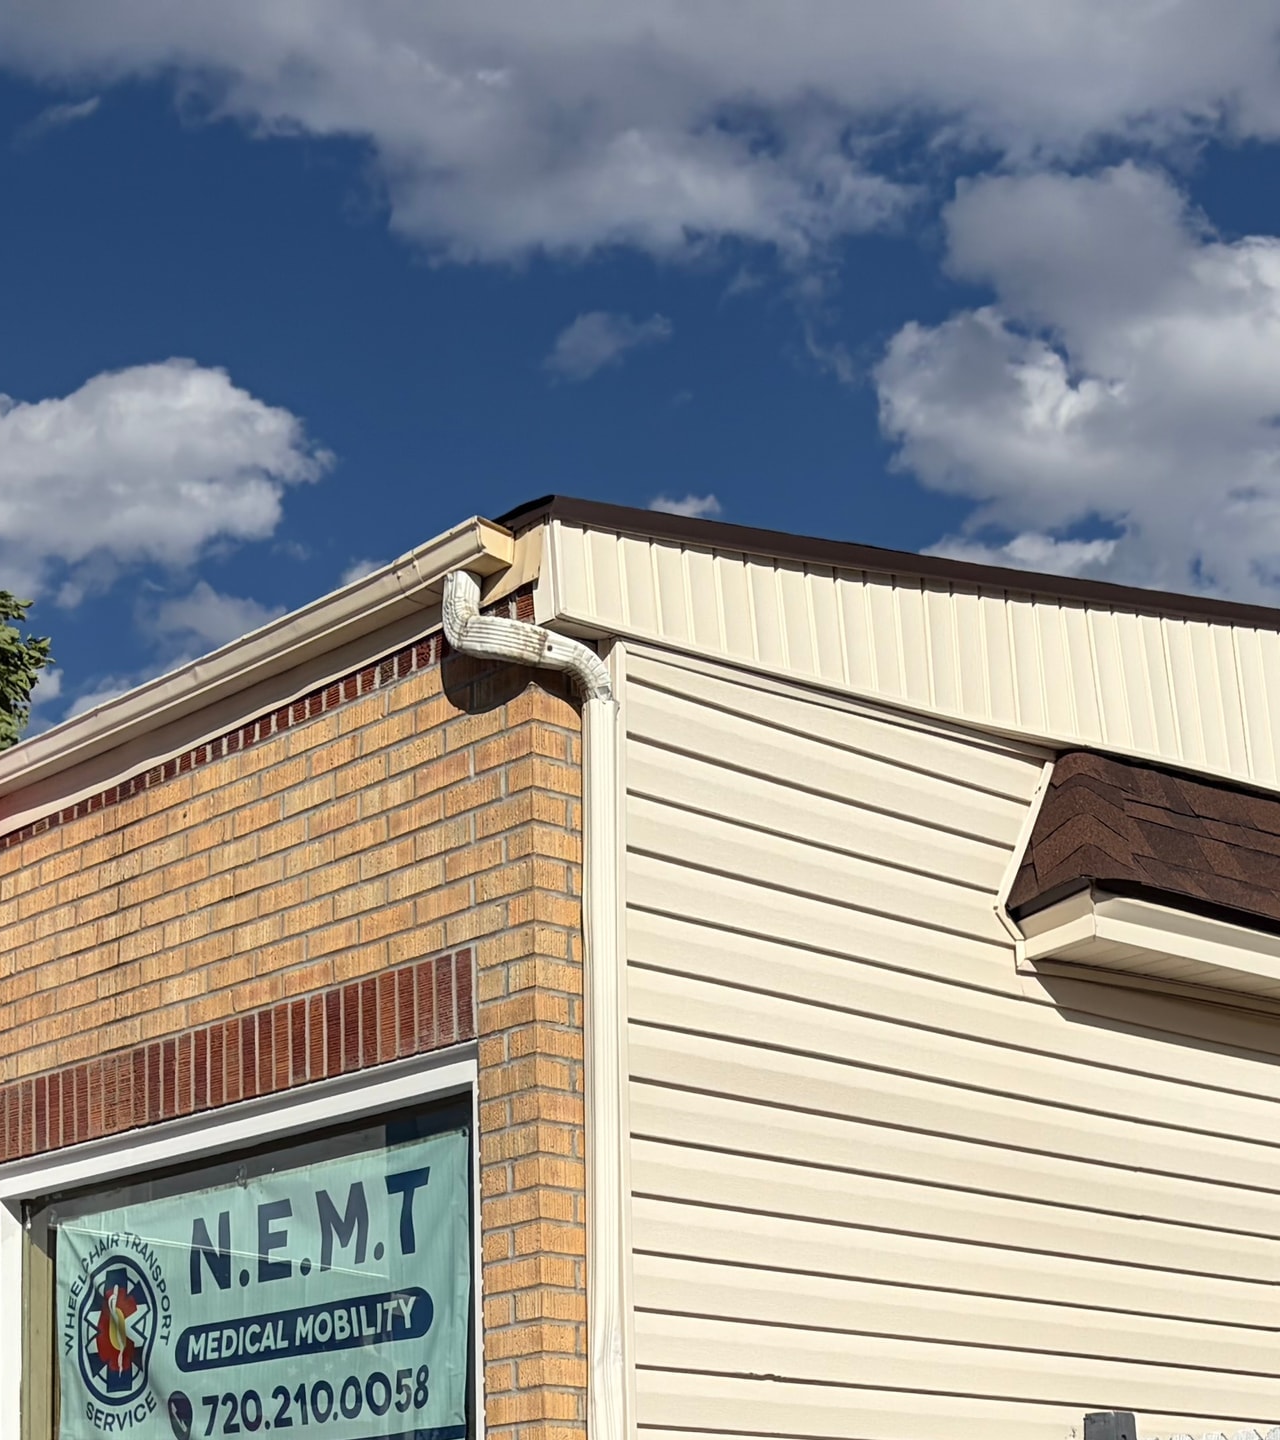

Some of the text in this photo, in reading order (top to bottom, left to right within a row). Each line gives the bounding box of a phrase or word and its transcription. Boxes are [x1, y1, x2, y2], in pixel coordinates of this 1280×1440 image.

[189, 1166, 430, 1295] N.E.M.T
[64, 1231, 172, 1356] WHEELCHAIR TRANSPORT
[186, 1296, 418, 1364] MEDICAL MOBILITY
[86, 1390, 158, 1433] SERVICE
[202, 1364, 430, 1437] 720.210.0058
